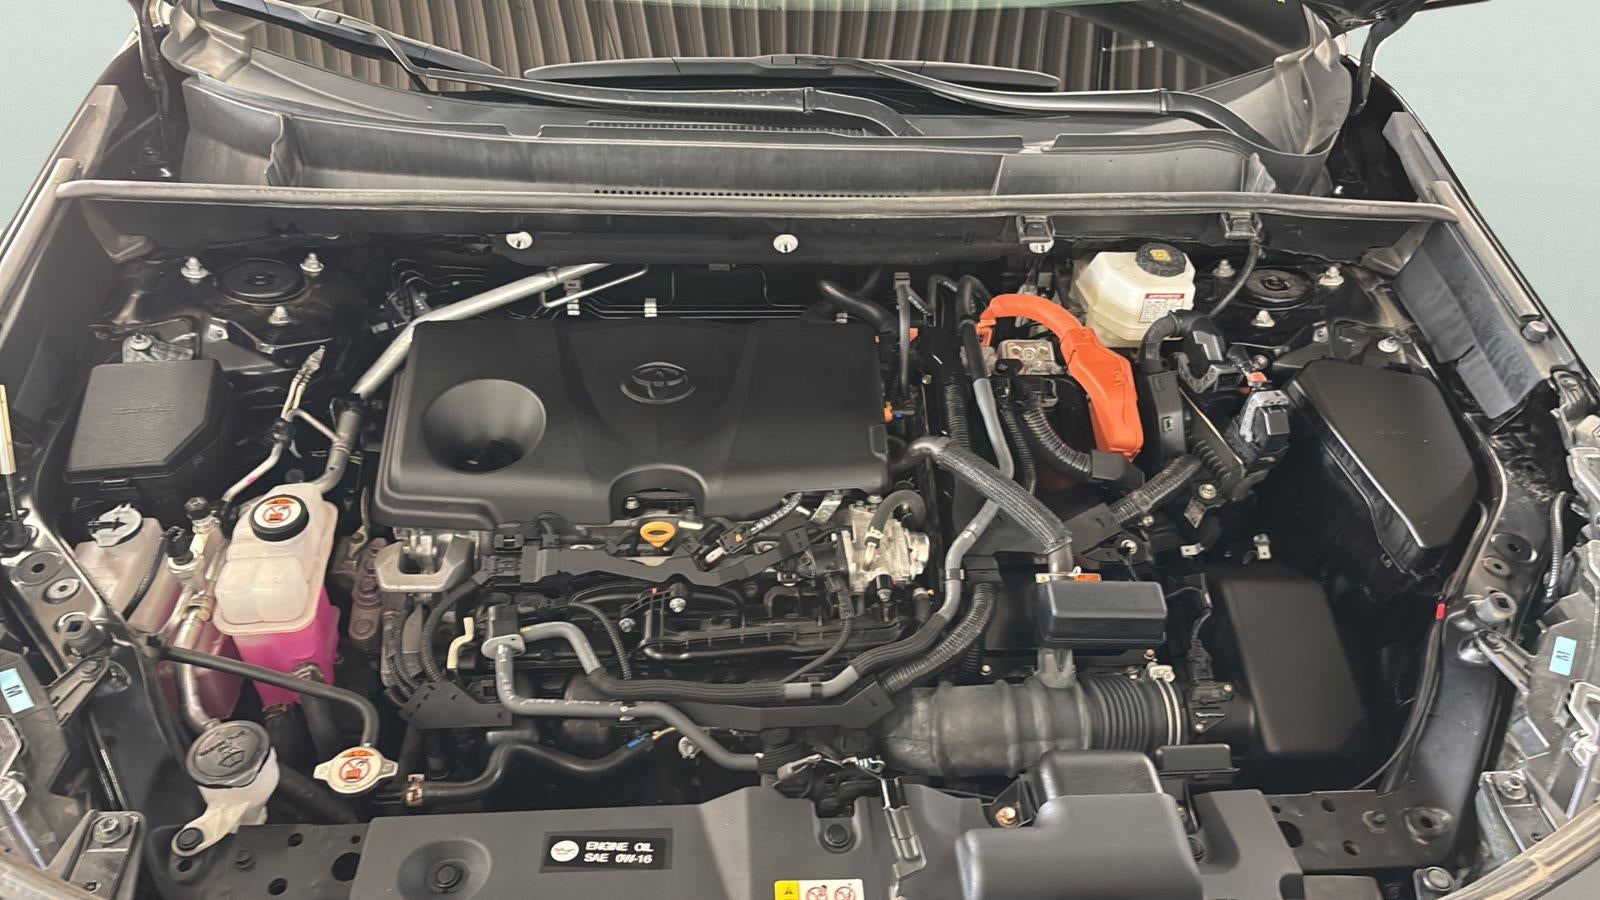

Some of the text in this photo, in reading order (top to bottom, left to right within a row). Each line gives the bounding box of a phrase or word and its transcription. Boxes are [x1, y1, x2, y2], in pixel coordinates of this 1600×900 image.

[585, 841, 654, 852] ENGINE OIL
[584, 853, 653, 864] SAE 0W-16
